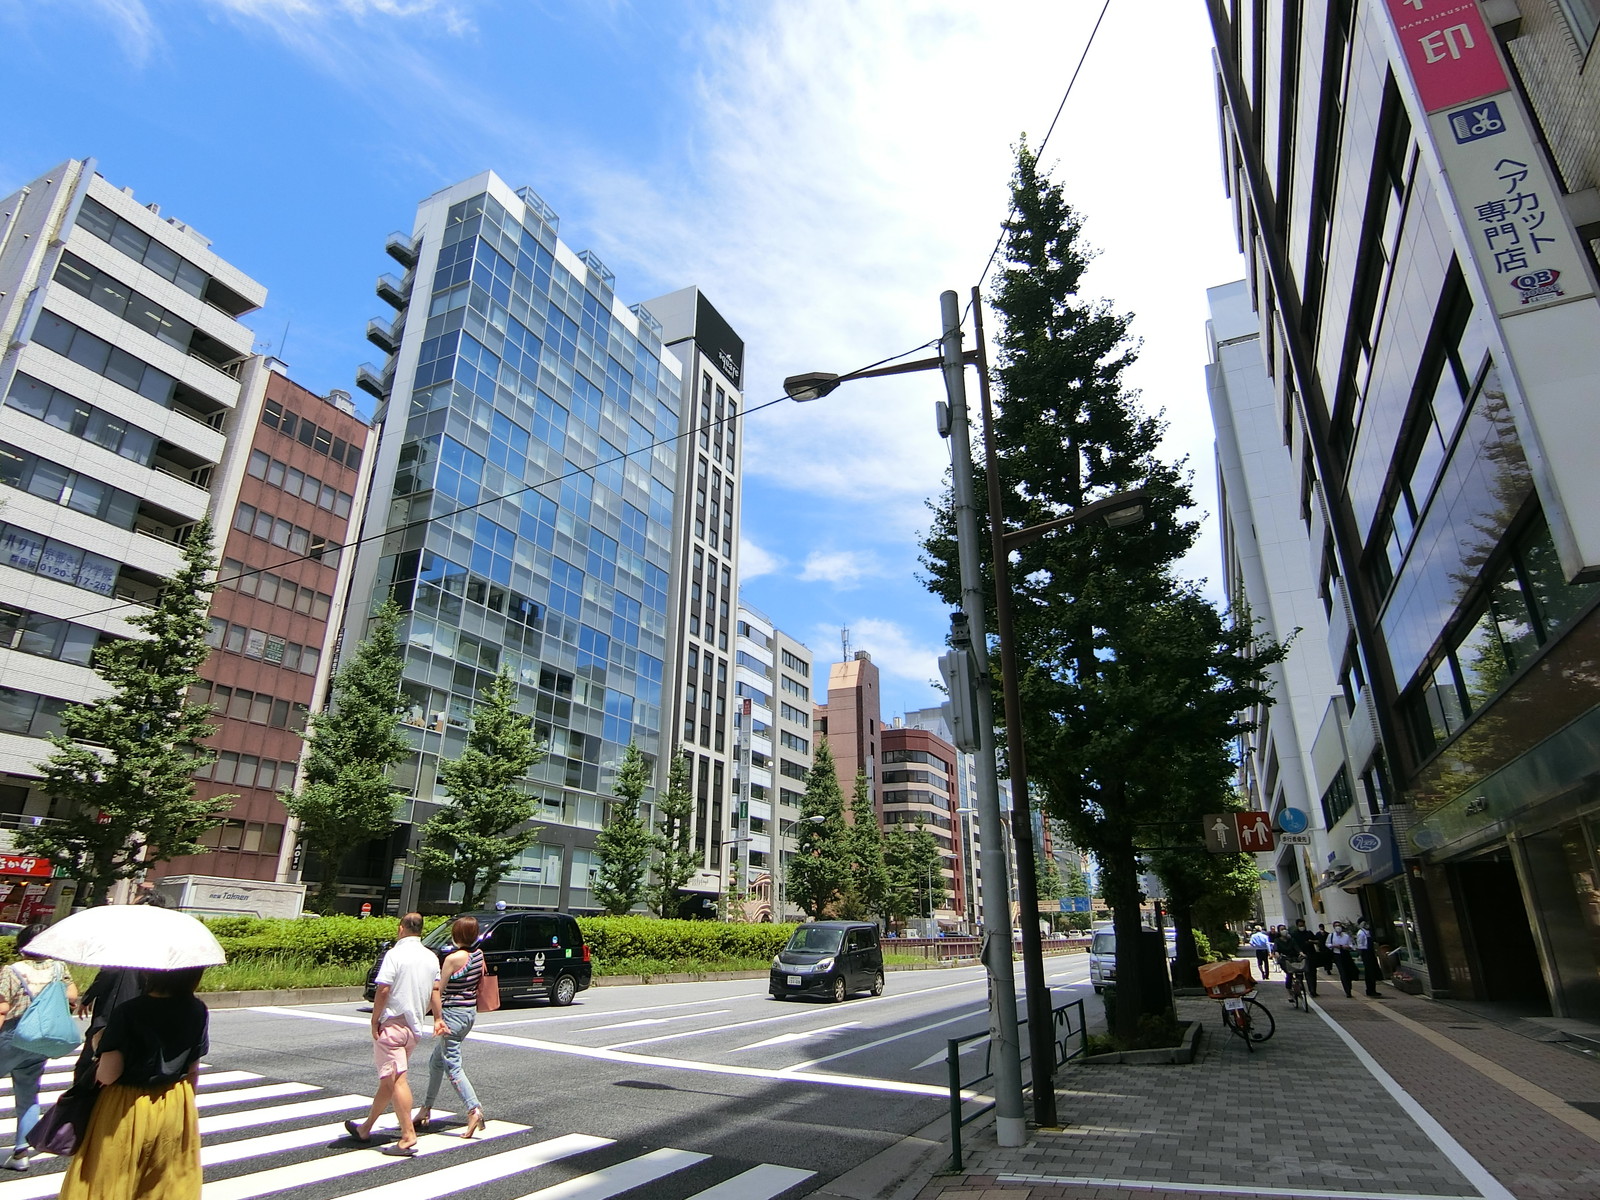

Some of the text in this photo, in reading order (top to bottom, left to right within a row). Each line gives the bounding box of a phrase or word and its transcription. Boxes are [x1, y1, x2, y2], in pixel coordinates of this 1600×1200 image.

[1417, 23, 1475, 64] 印
[1493, 159, 1555, 254] ヘアカット
[1474, 199, 1528, 274] 専門店
[1519, 271, 1552, 288] QB
[1521, 284, 1560, 298] HOUSE
